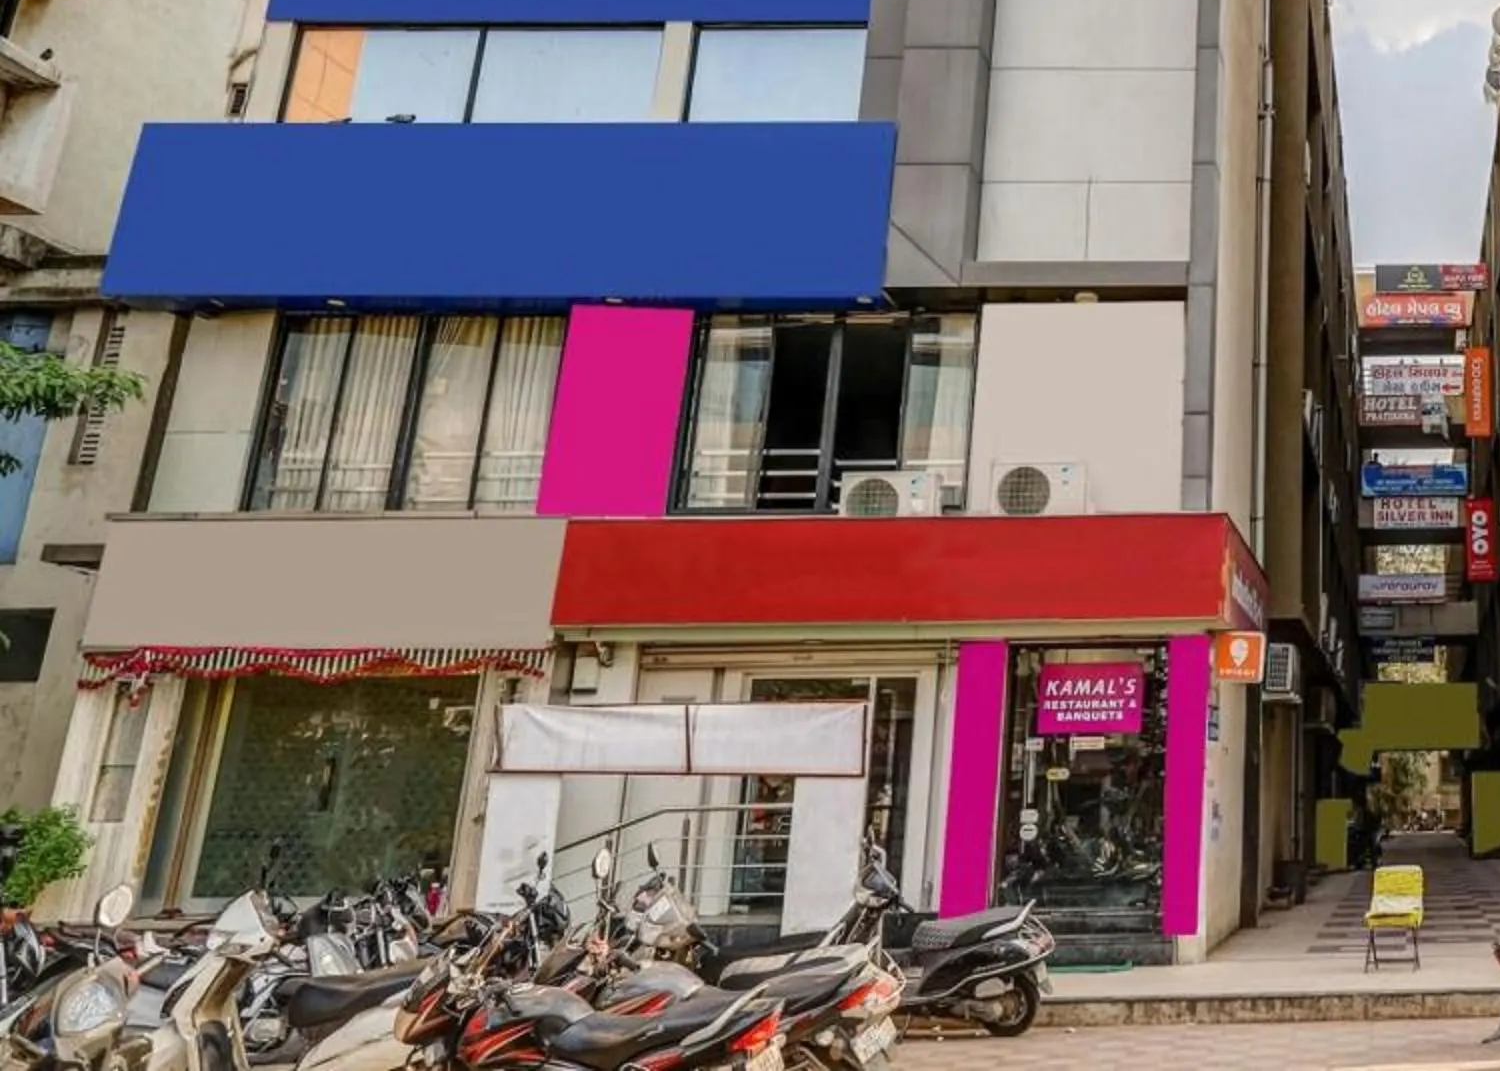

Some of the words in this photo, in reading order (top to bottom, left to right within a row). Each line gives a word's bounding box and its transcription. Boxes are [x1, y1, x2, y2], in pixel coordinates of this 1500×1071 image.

[1364, 397, 1417, 411] HOTEL
[1381, 498, 1437, 509] HOTEL
[1377, 510, 1426, 521] SILVER
[1431, 510, 1453, 521] INN
[1472, 510, 1488, 555] OYO
[1045, 677, 1137, 696] KAMAL'S
[1044, 699, 1125, 709] RESTAURANT
[1056, 711, 1124, 721] BANQUETS
